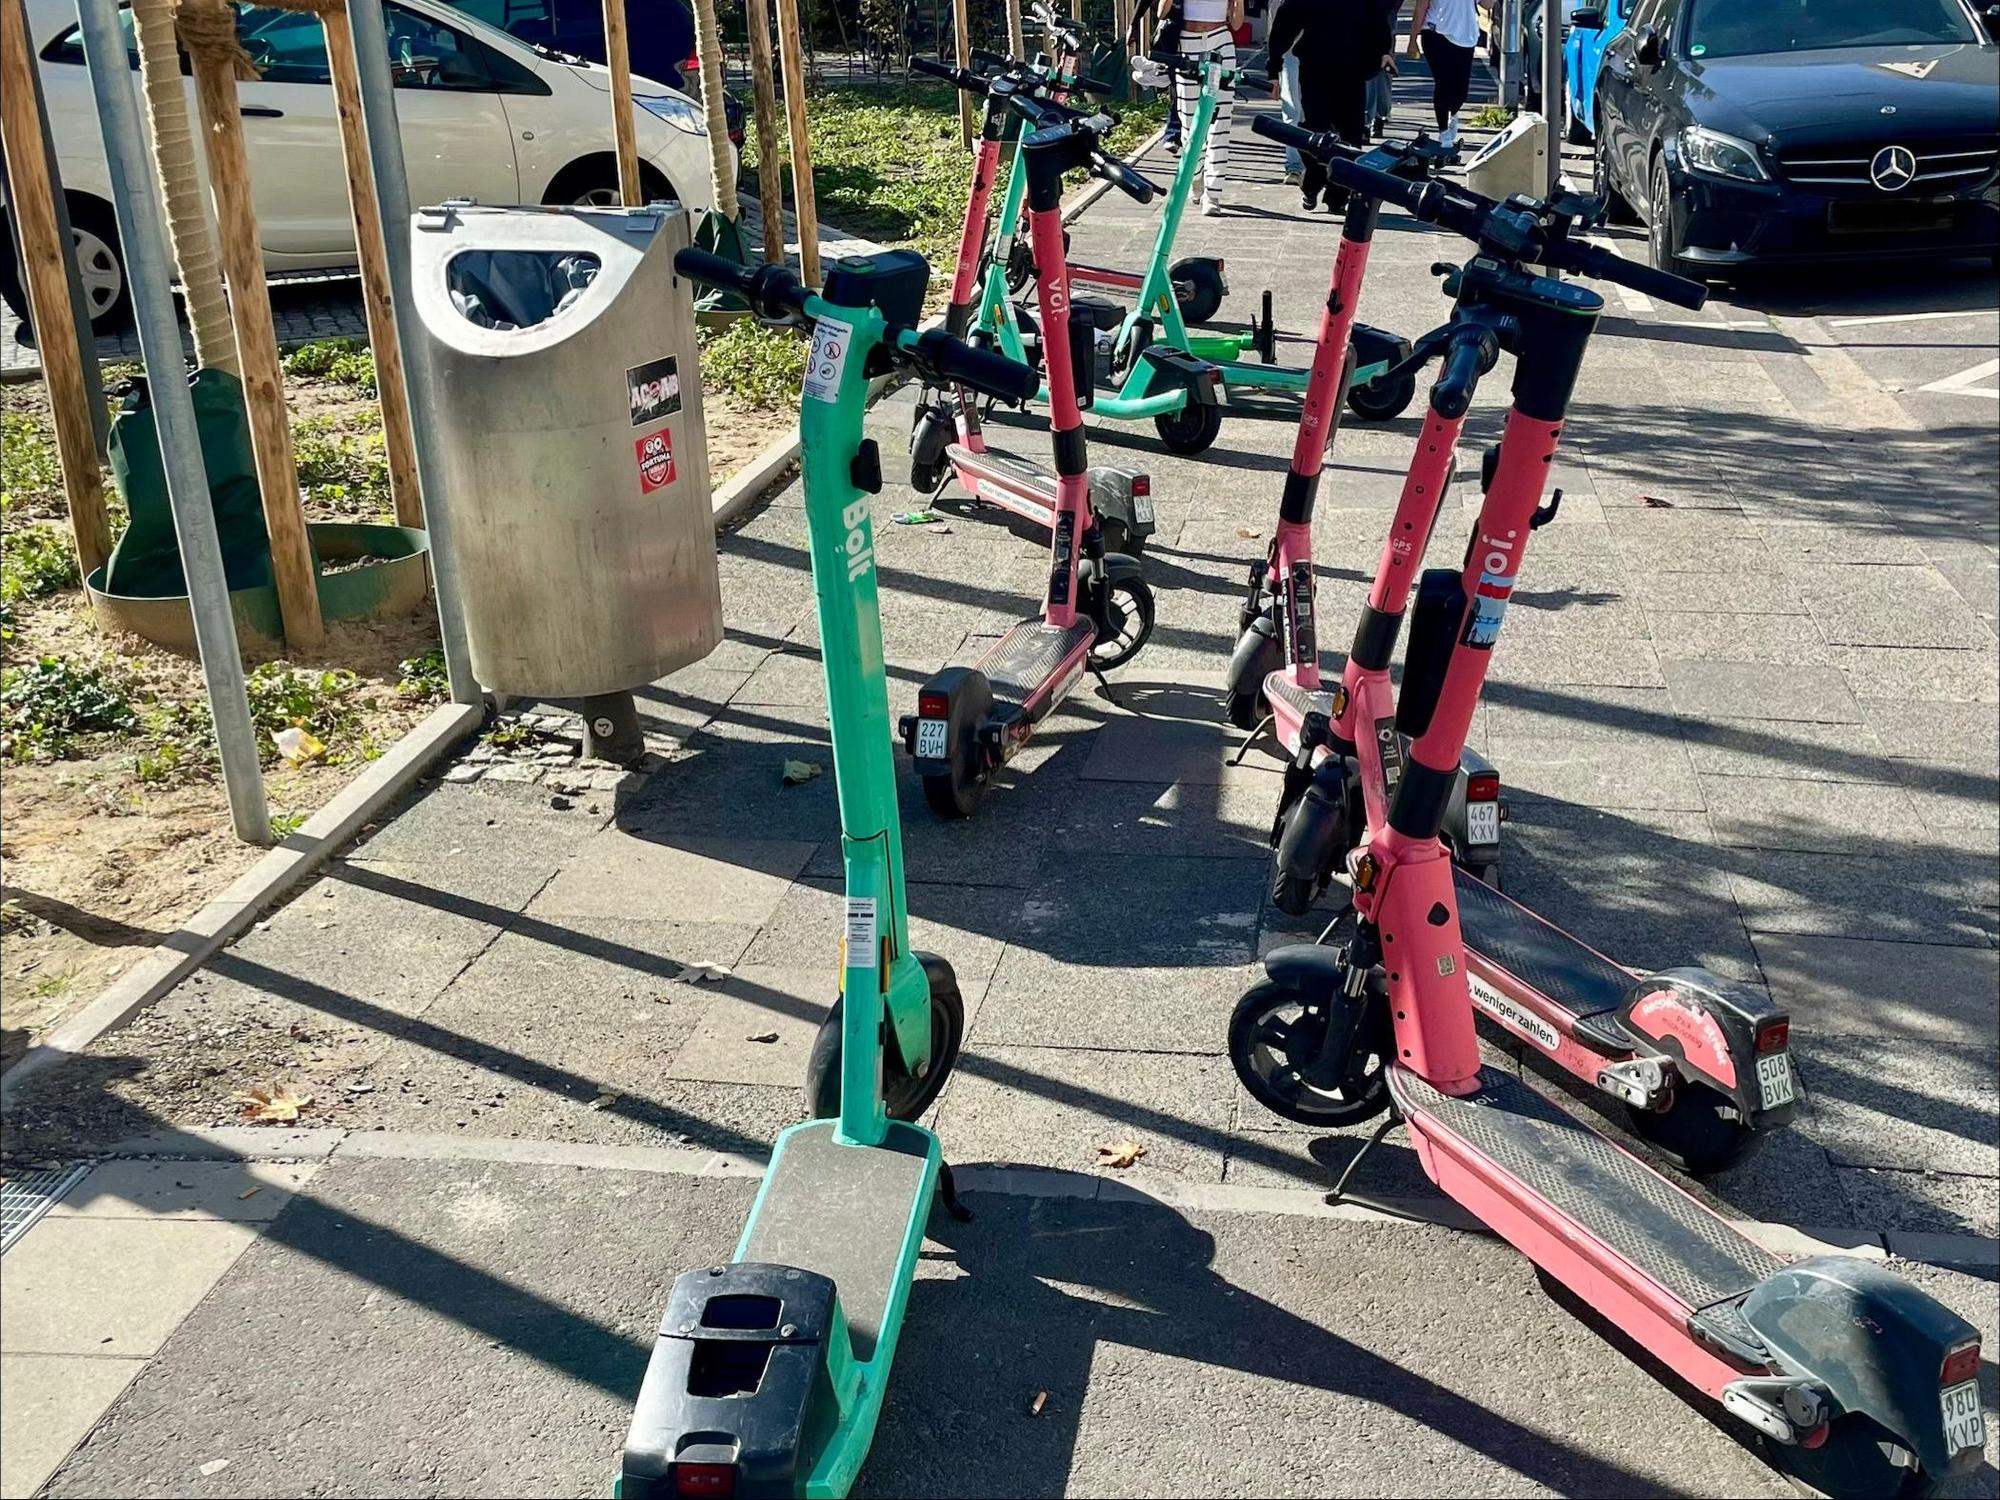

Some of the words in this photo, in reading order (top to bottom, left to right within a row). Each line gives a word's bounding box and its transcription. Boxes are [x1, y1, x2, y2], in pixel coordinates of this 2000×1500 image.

[1048, 277, 1068, 321] voi.
[641, 452, 671, 472] FORTUNA
[842, 495, 873, 583] Bolt
[1392, 537, 1413, 552] GPS
[1482, 529, 1517, 575] oi.
[921, 722, 944, 738] 227
[919, 739, 944, 755] BVH
[1471, 805, 1494, 821] 467
[1471, 824, 1495, 841] KXY
[1474, 985, 1517, 1019] weniger
[1518, 1013, 1556, 1047] zahlen.
[1760, 1055, 1786, 1081] 508
[1763, 1077, 1792, 1105] BVK
[1945, 1387, 1976, 1421] 980
[1948, 1417, 1980, 1452] KYP
